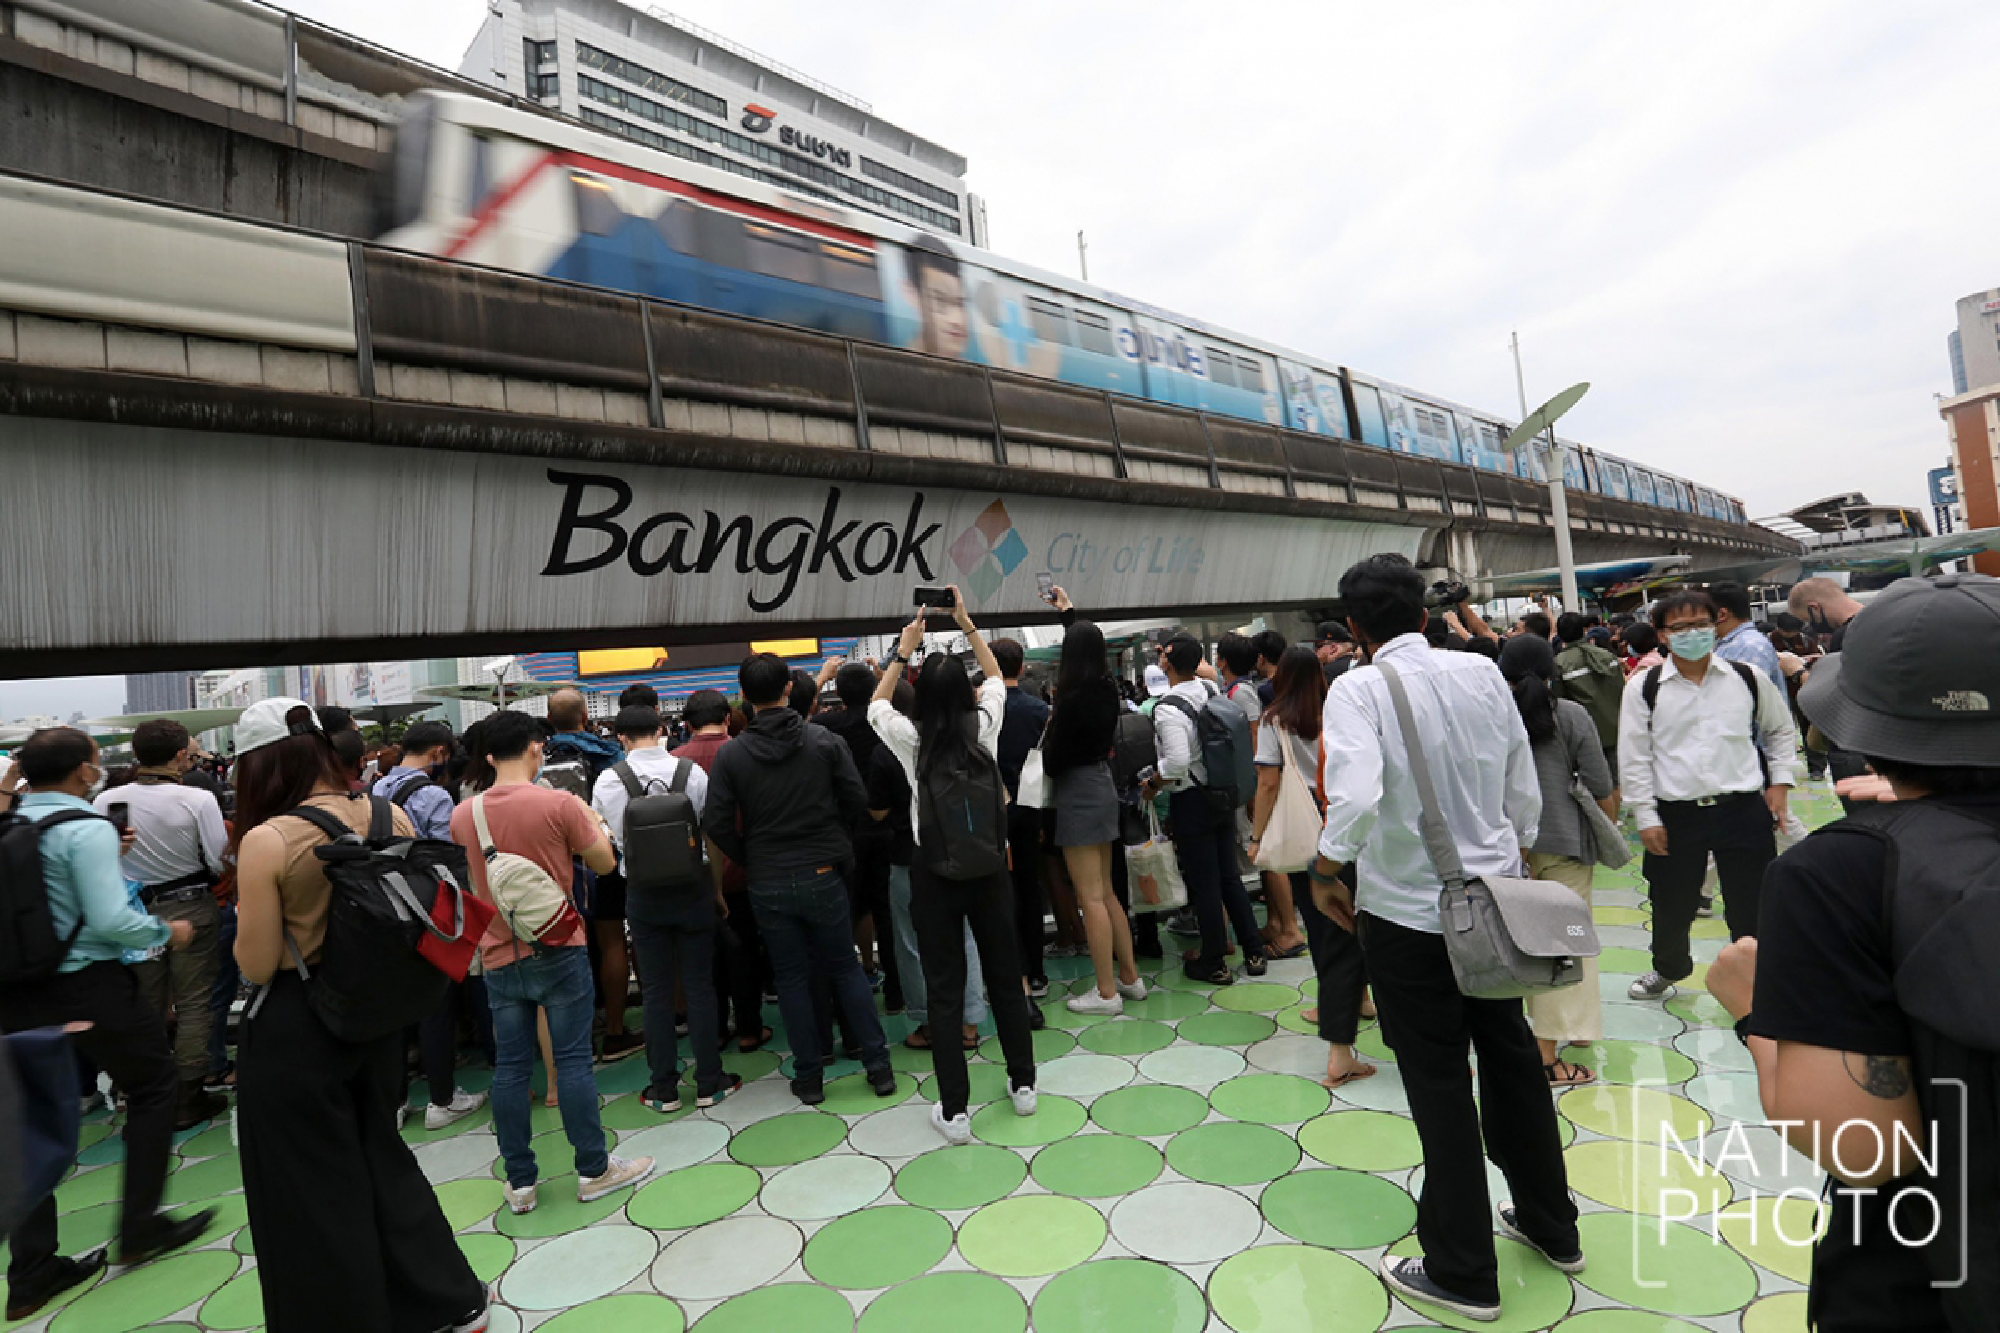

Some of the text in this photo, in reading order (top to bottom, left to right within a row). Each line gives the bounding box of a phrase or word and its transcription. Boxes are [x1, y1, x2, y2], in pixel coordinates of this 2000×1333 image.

[540, 467, 943, 613] Bangkok
[1046, 532, 1205, 583] City of Life
